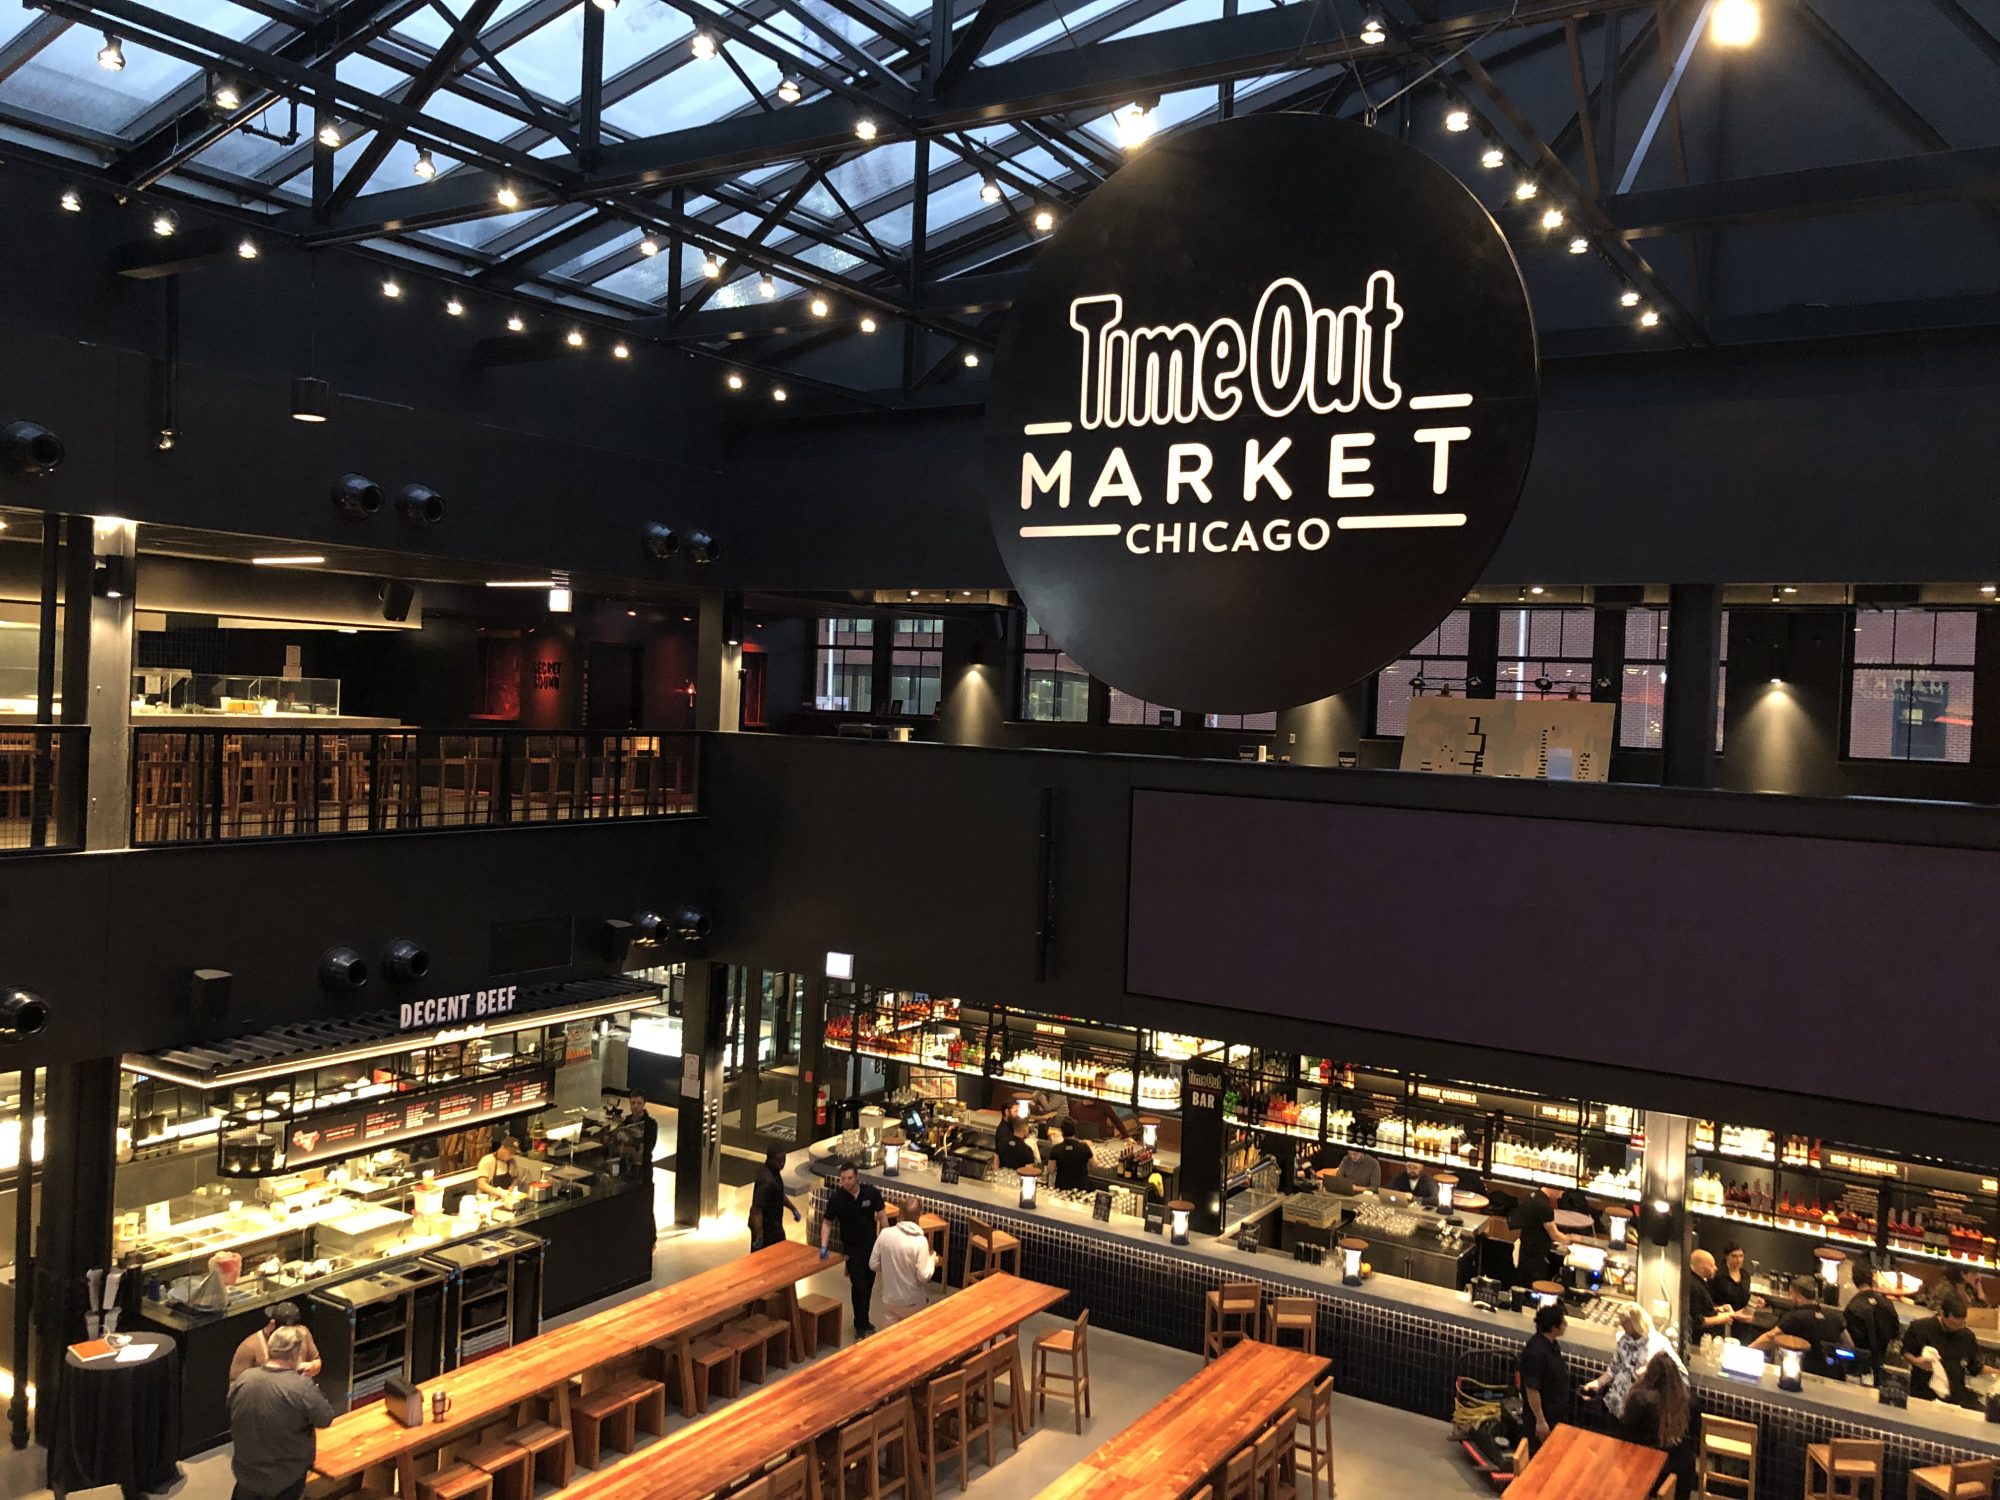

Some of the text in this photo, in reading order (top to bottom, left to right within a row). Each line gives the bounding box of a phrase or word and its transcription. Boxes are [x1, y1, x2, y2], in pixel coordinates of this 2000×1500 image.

[1020, 426, 1472, 510] MARKET
[1126, 517, 1331, 555] CHICAGO
[400, 986, 517, 1029] DECENT BEEF
[1192, 1091, 1215, 1109] BAR
